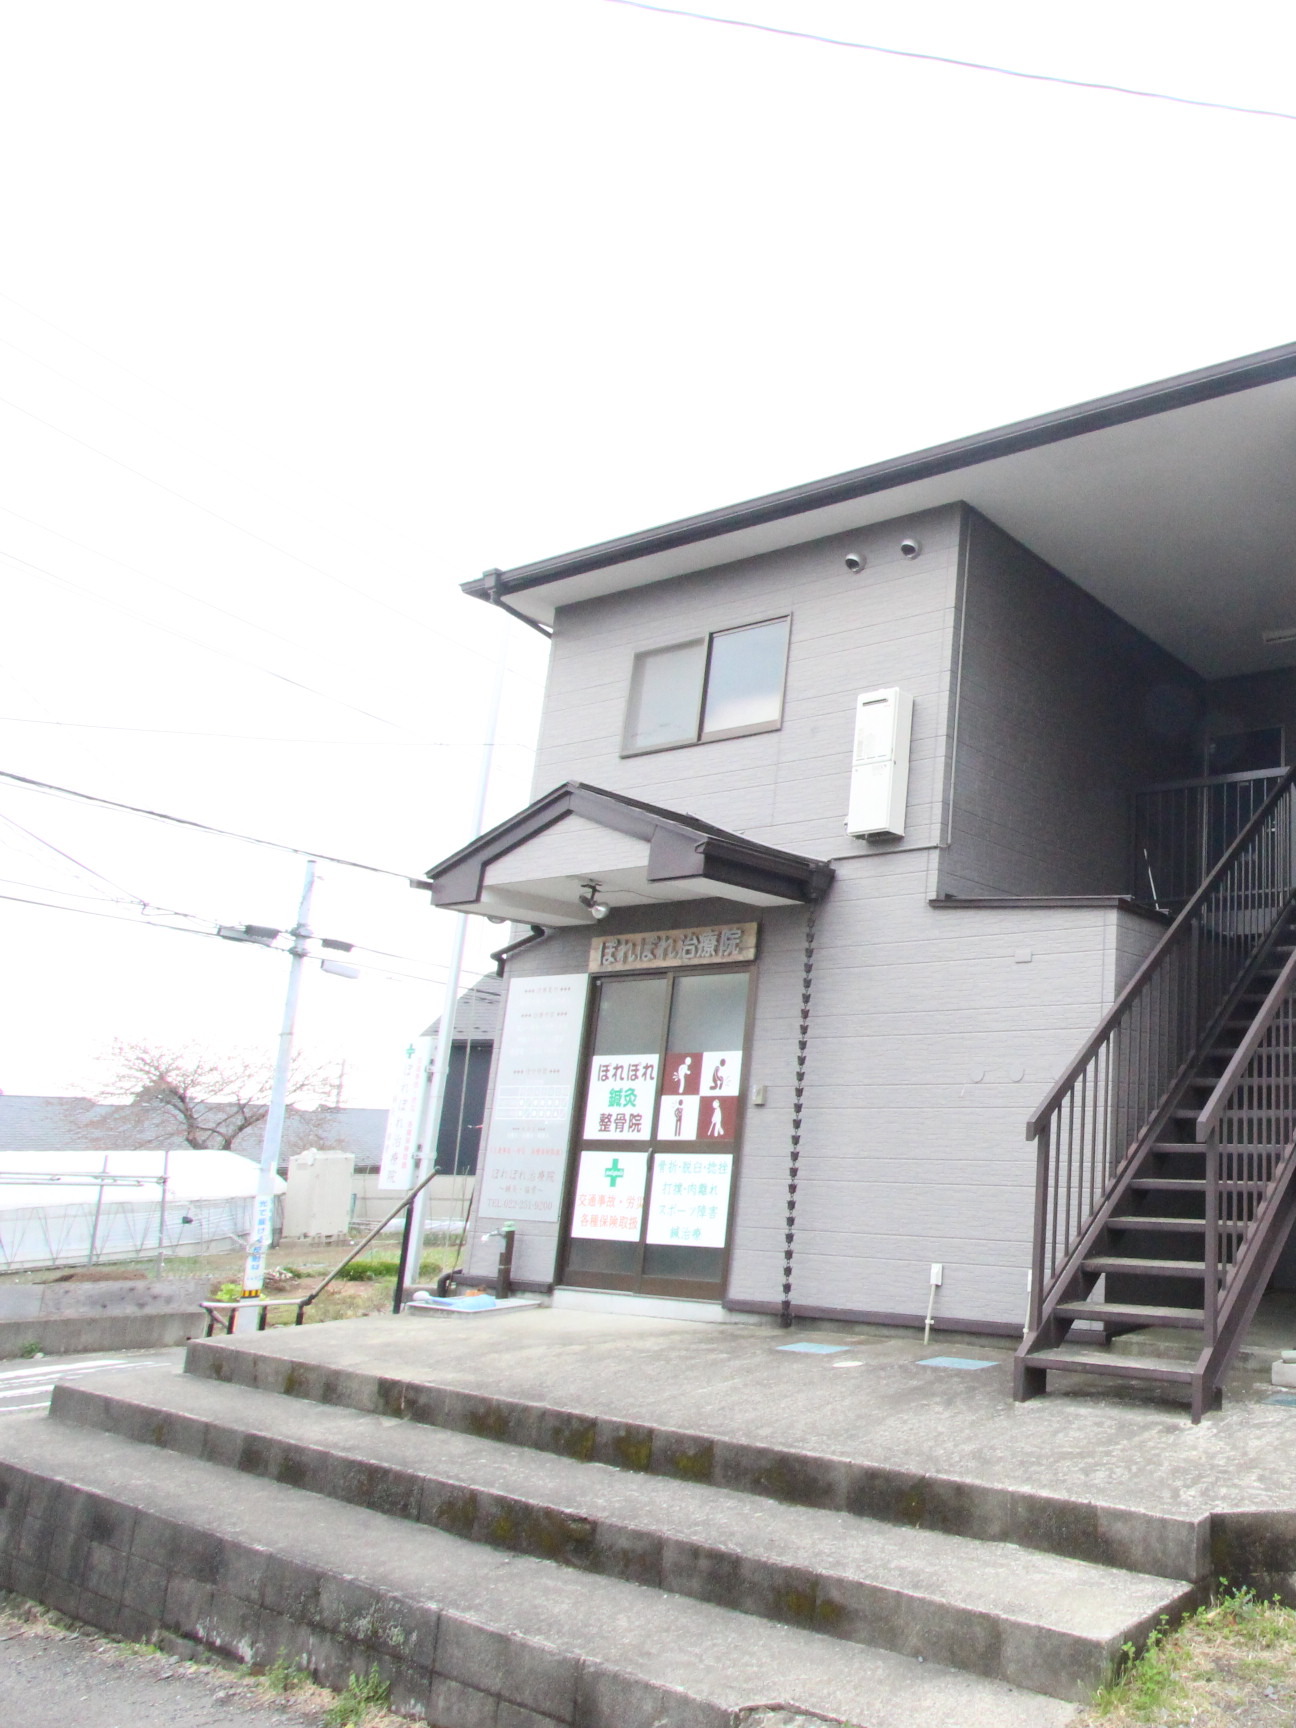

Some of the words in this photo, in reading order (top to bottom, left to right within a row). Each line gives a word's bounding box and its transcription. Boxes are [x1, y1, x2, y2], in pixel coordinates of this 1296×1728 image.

[598, 929, 742, 967] ぽれぽれ治療院
[597, 1062, 656, 1082] ぽれぽれ
[607, 1087, 638, 1108] 鍼灸
[597, 1112, 643, 1133] 整骨院
[658, 1203, 719, 1219] スポーツ障害
